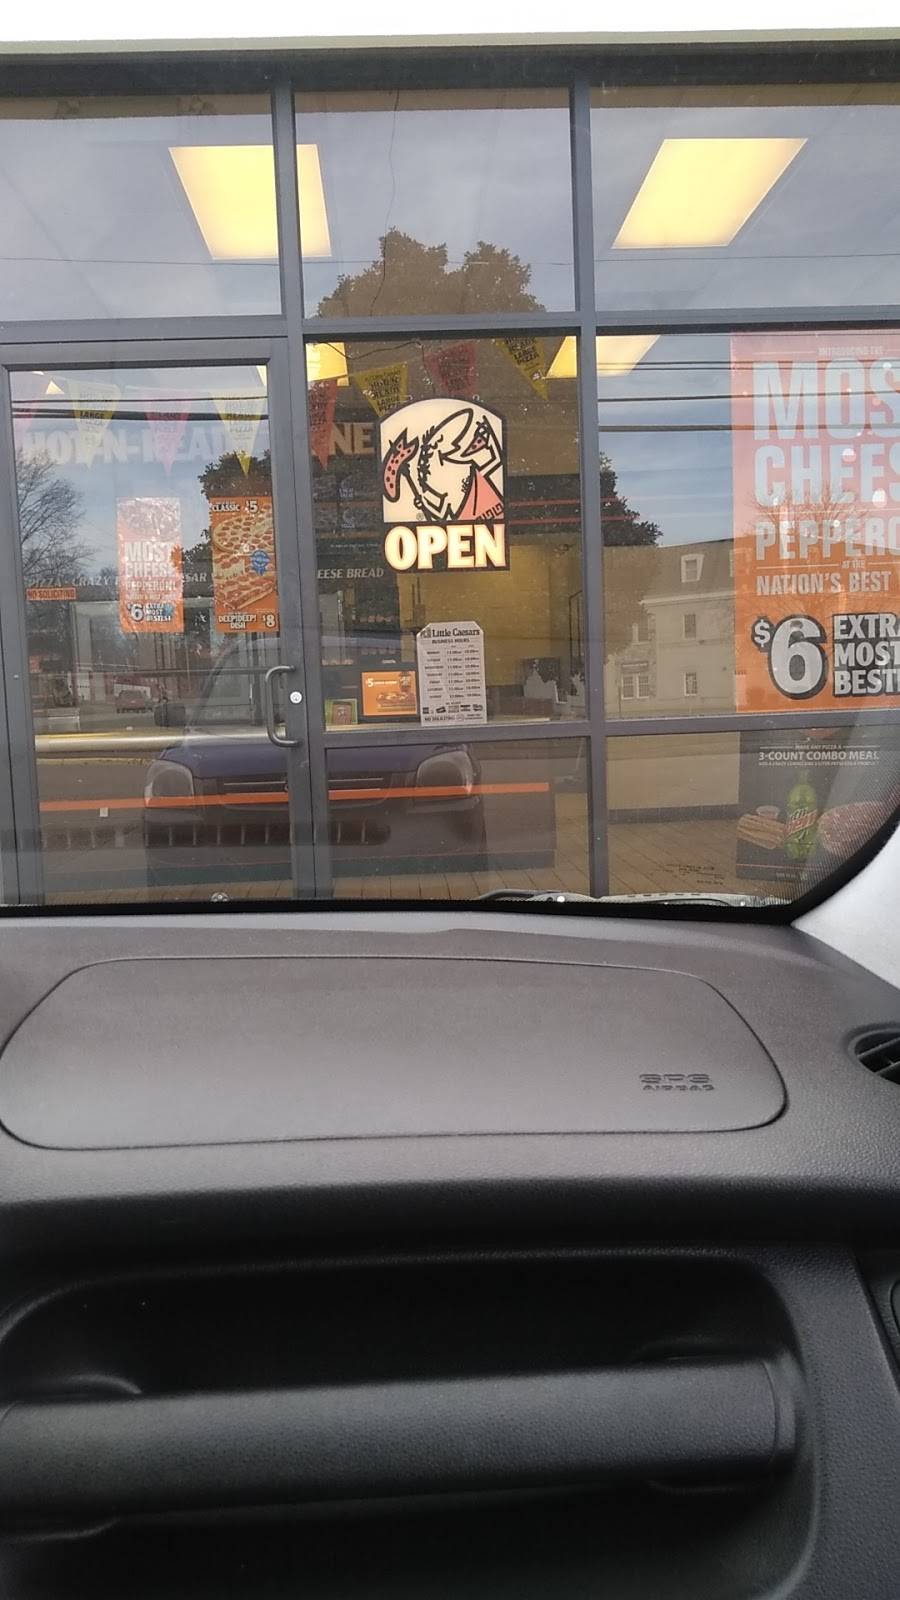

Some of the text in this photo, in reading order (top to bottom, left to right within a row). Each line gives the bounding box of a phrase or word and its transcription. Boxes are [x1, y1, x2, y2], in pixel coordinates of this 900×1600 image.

[385, 524, 506, 571] OPEN
[346, 567, 384, 579] BREAD
[73, 575, 110, 587] CRAZY
[756, 571, 892, 596] NATION'S BEST
[431, 628, 480, 638] Little Caesars
[758, 751, 805, 761] 3-COUNT
[806, 751, 847, 761] COMBO
